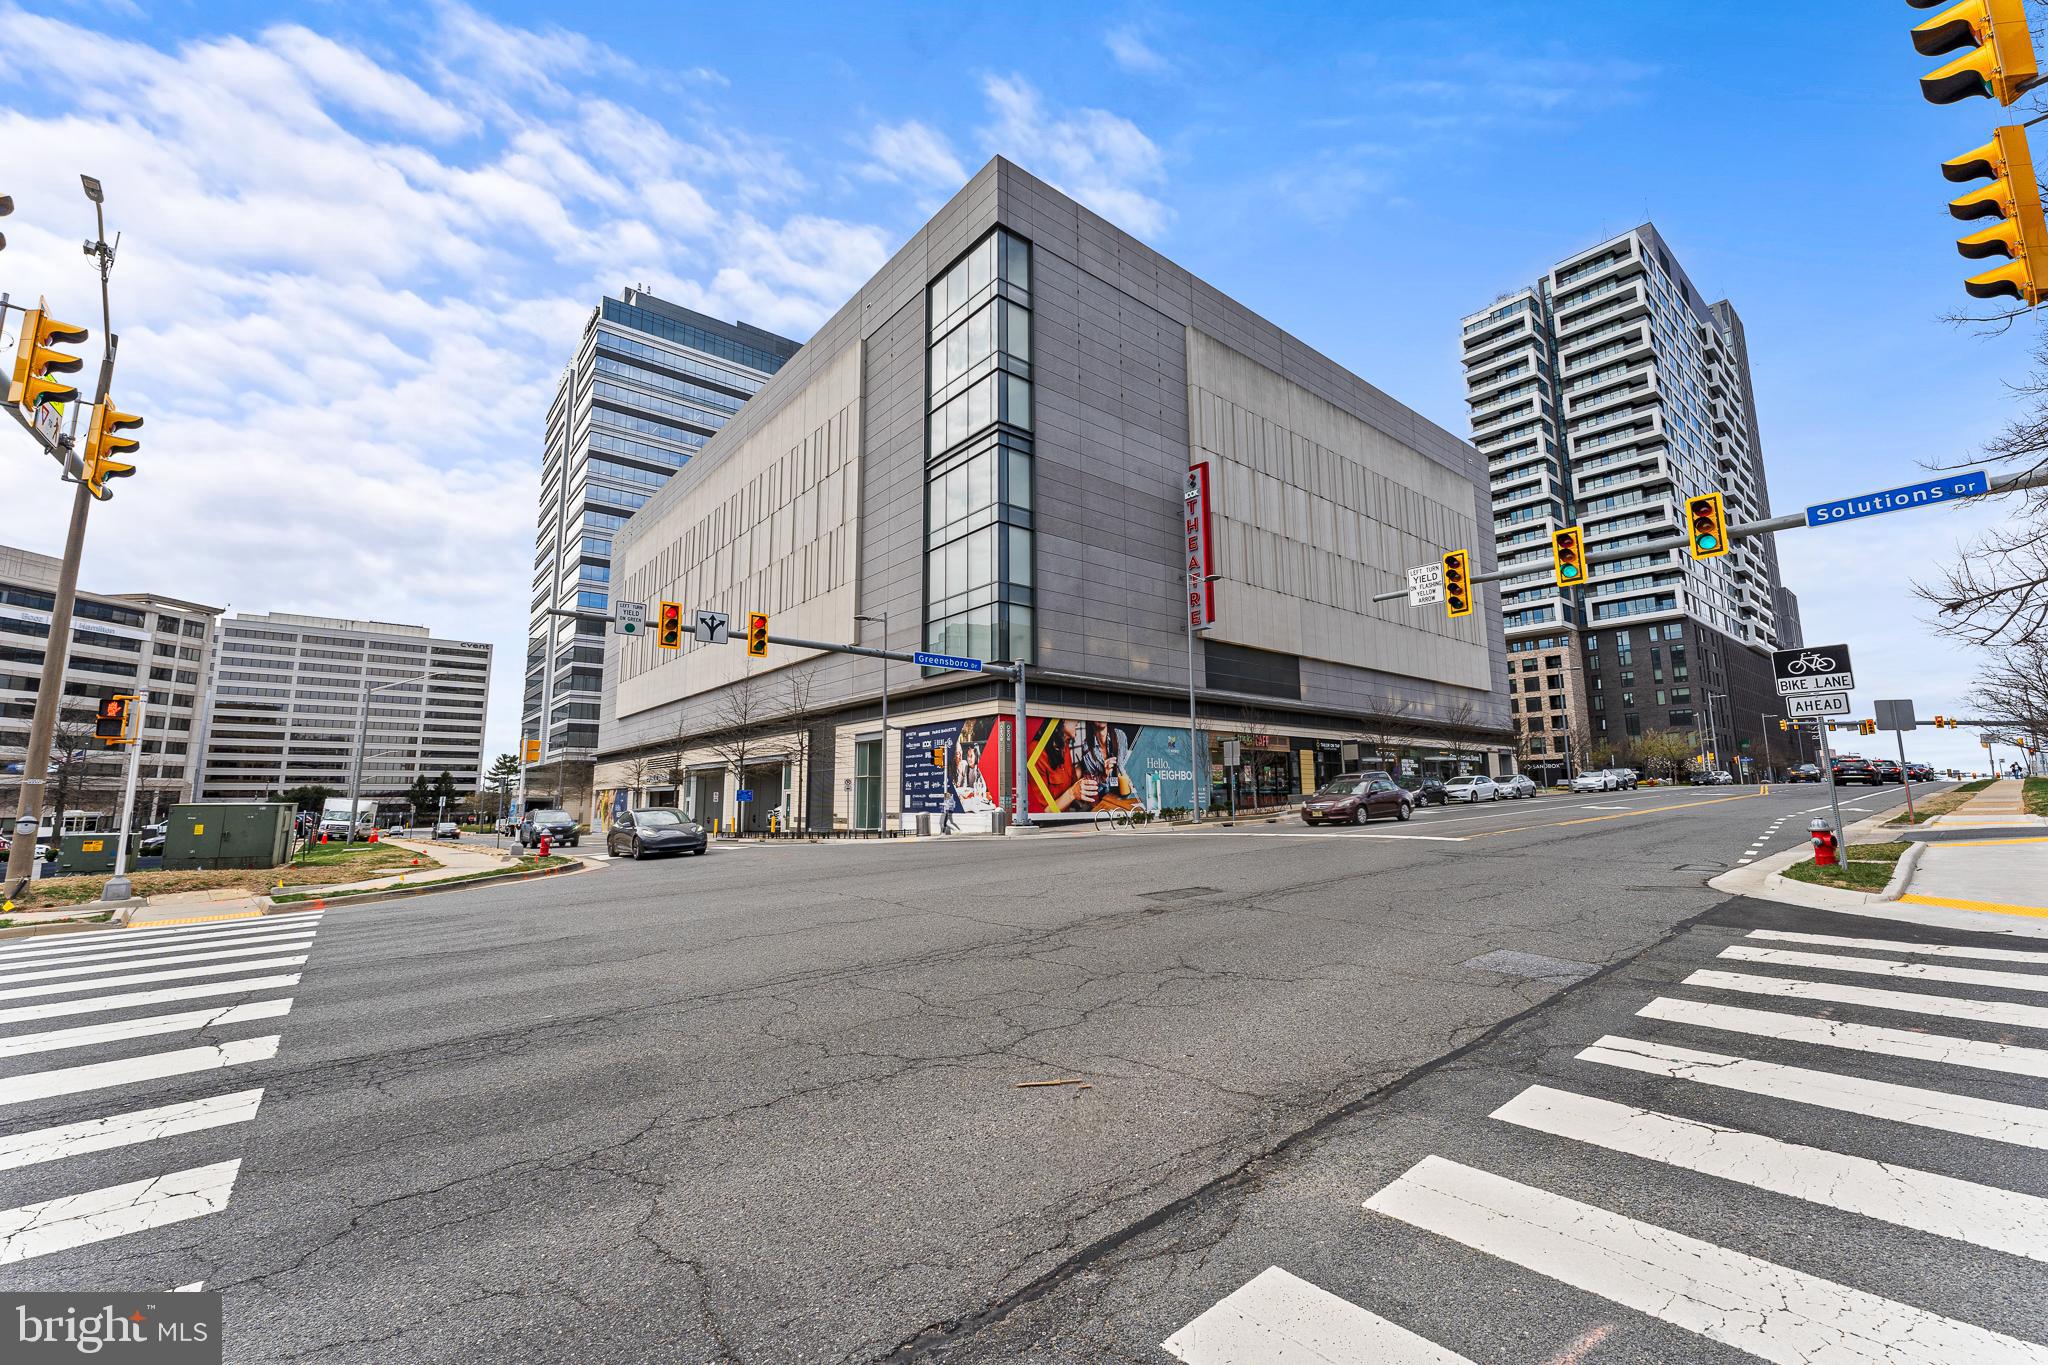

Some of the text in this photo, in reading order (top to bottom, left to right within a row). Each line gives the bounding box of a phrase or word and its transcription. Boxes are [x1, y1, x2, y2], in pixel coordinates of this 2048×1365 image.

[1816, 482, 1976, 521] Solutions Dr
[1186, 499, 1201, 626] THEATRE
[1413, 573, 1438, 583] YIELD
[1420, 580, 1441, 589] FLASHING
[918, 654, 968, 668] Greensboro
[1780, 675, 1850, 691] BIKE LANE
[1796, 699, 1842, 712] AHEAD
[1147, 758, 1170, 768] Hello,
